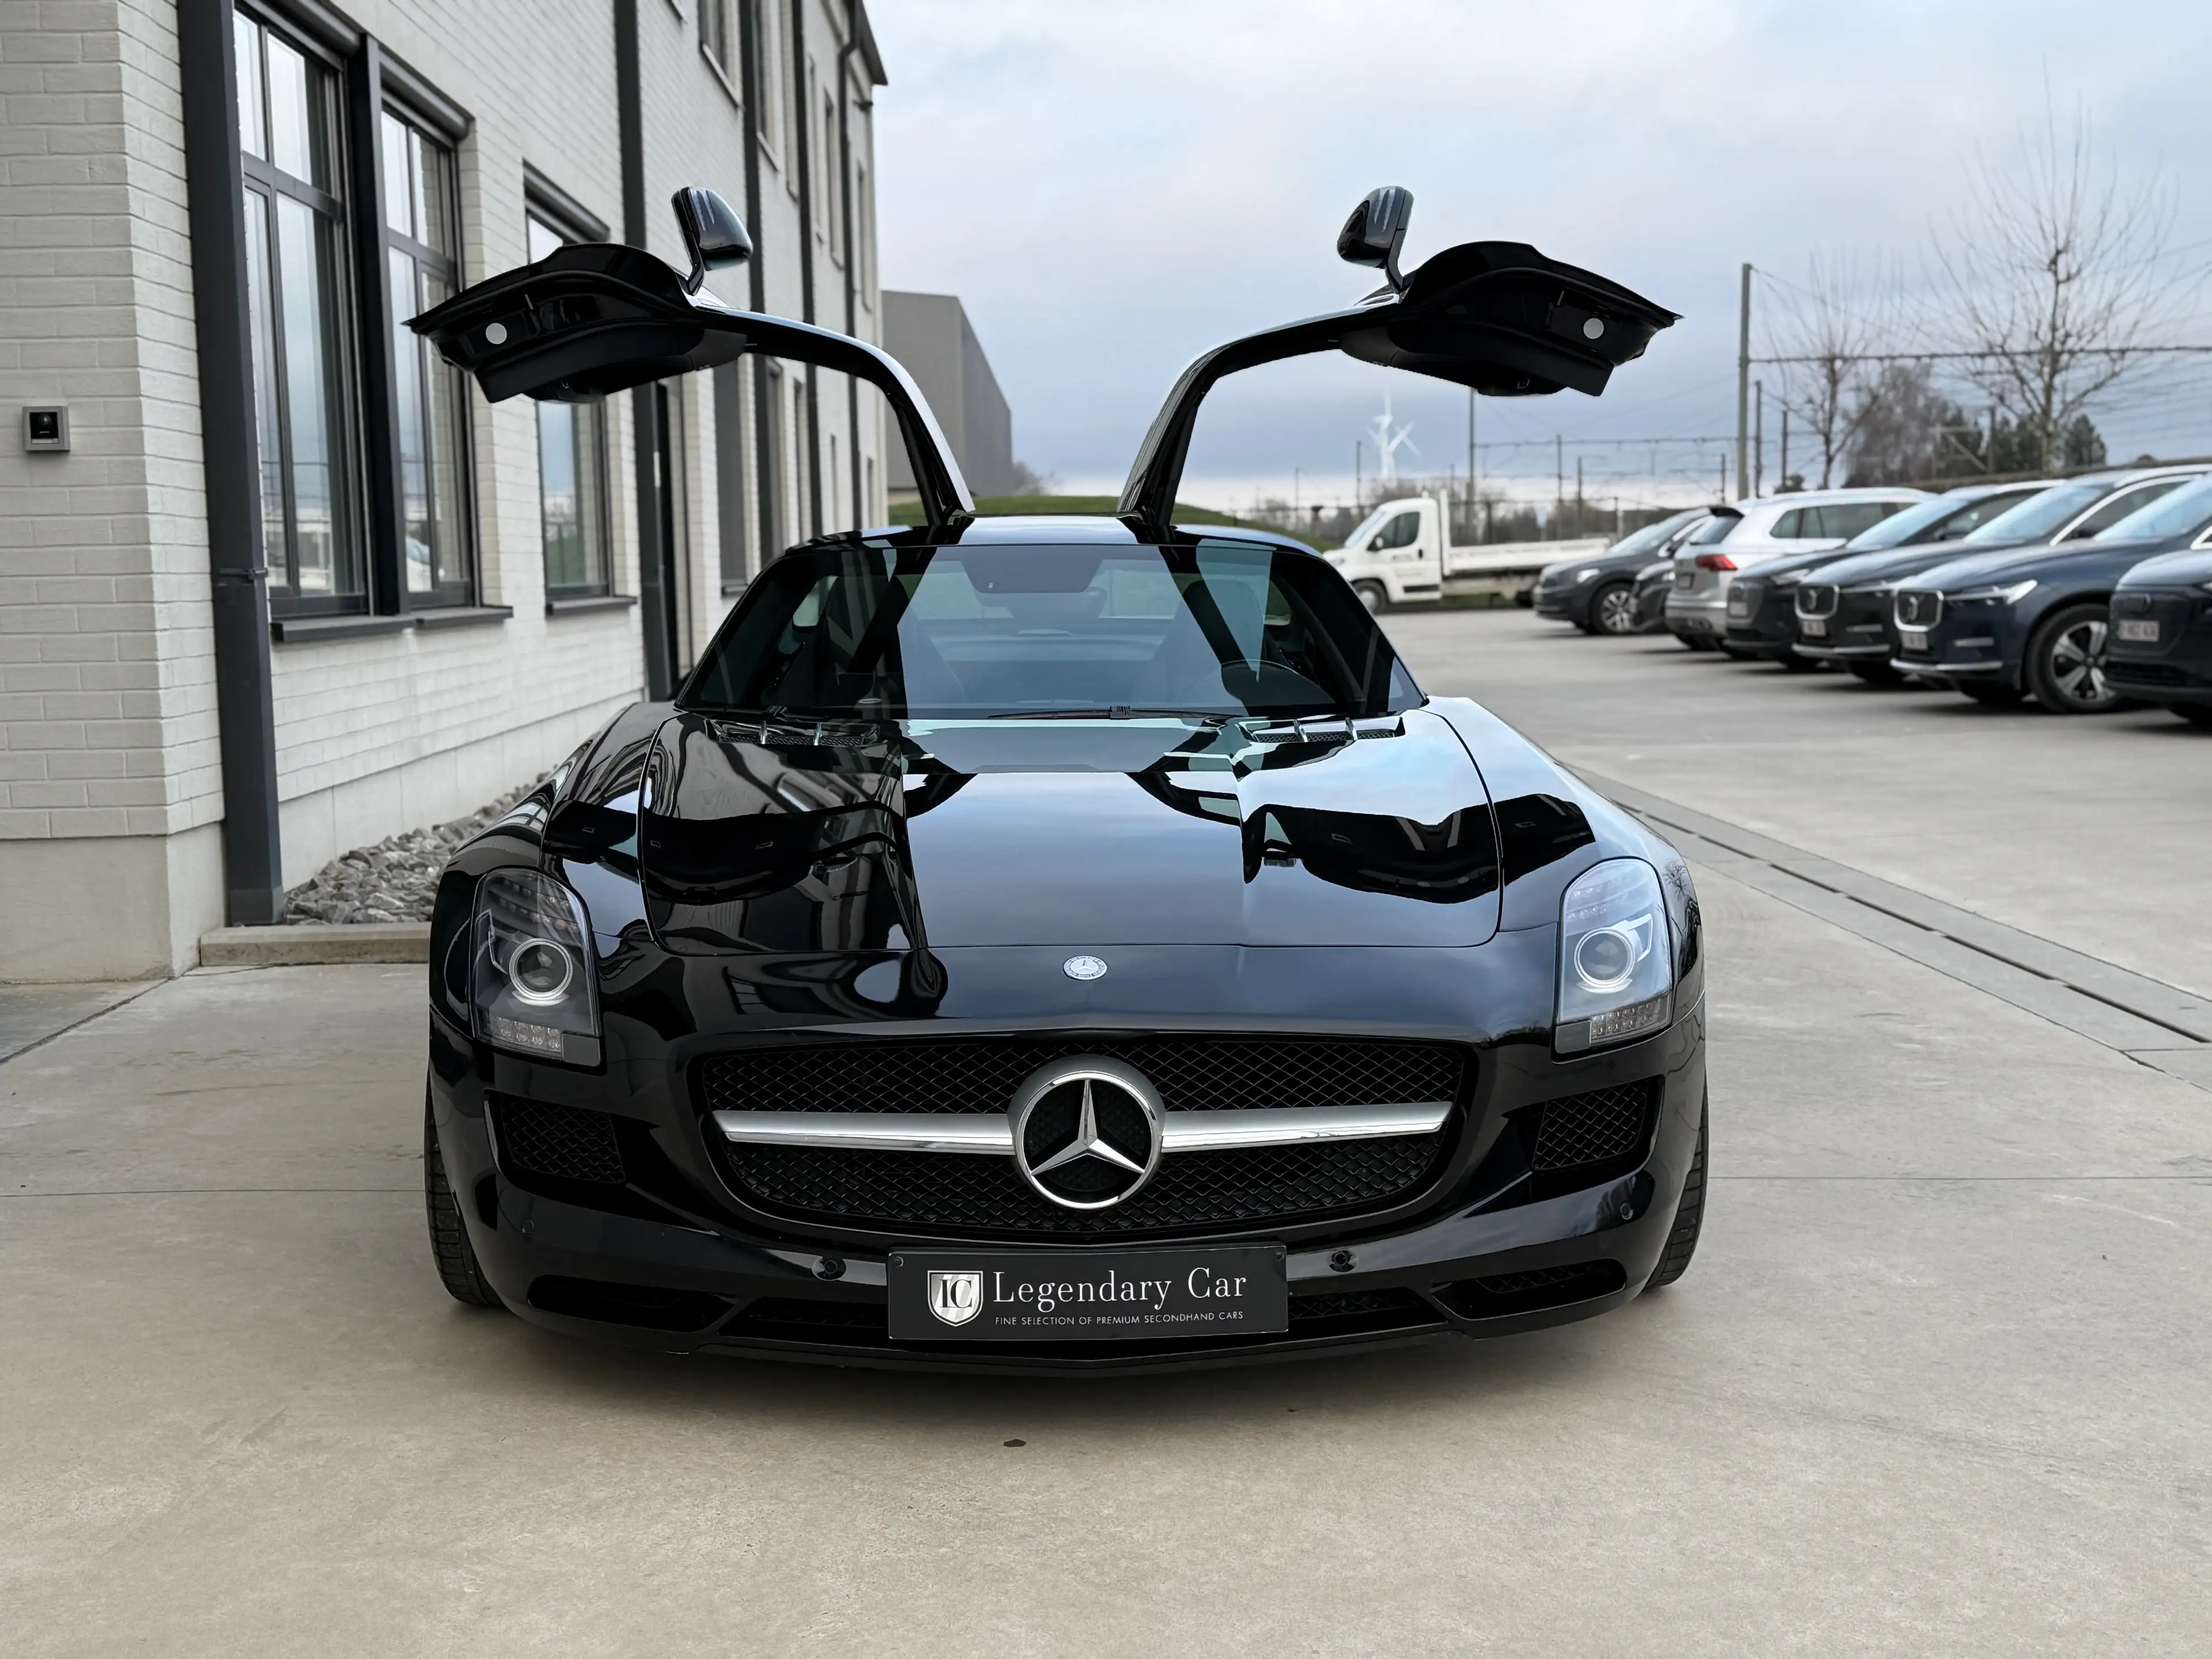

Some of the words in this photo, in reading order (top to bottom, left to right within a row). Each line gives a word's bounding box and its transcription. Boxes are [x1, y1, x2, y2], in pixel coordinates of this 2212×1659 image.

[993, 1270, 1172, 1313] Legendary
[1188, 1267, 1247, 1298] Car
[995, 1317, 1017, 1325] FINE
[1021, 1317, 1074, 1325] SELECTION
[1078, 1317, 1092, 1325] OF
[1096, 1316, 1140, 1324] PREMIUM
[1144, 1312, 1214, 1323] SECONDHAND
[1218, 1311, 1243, 1320] CARS
